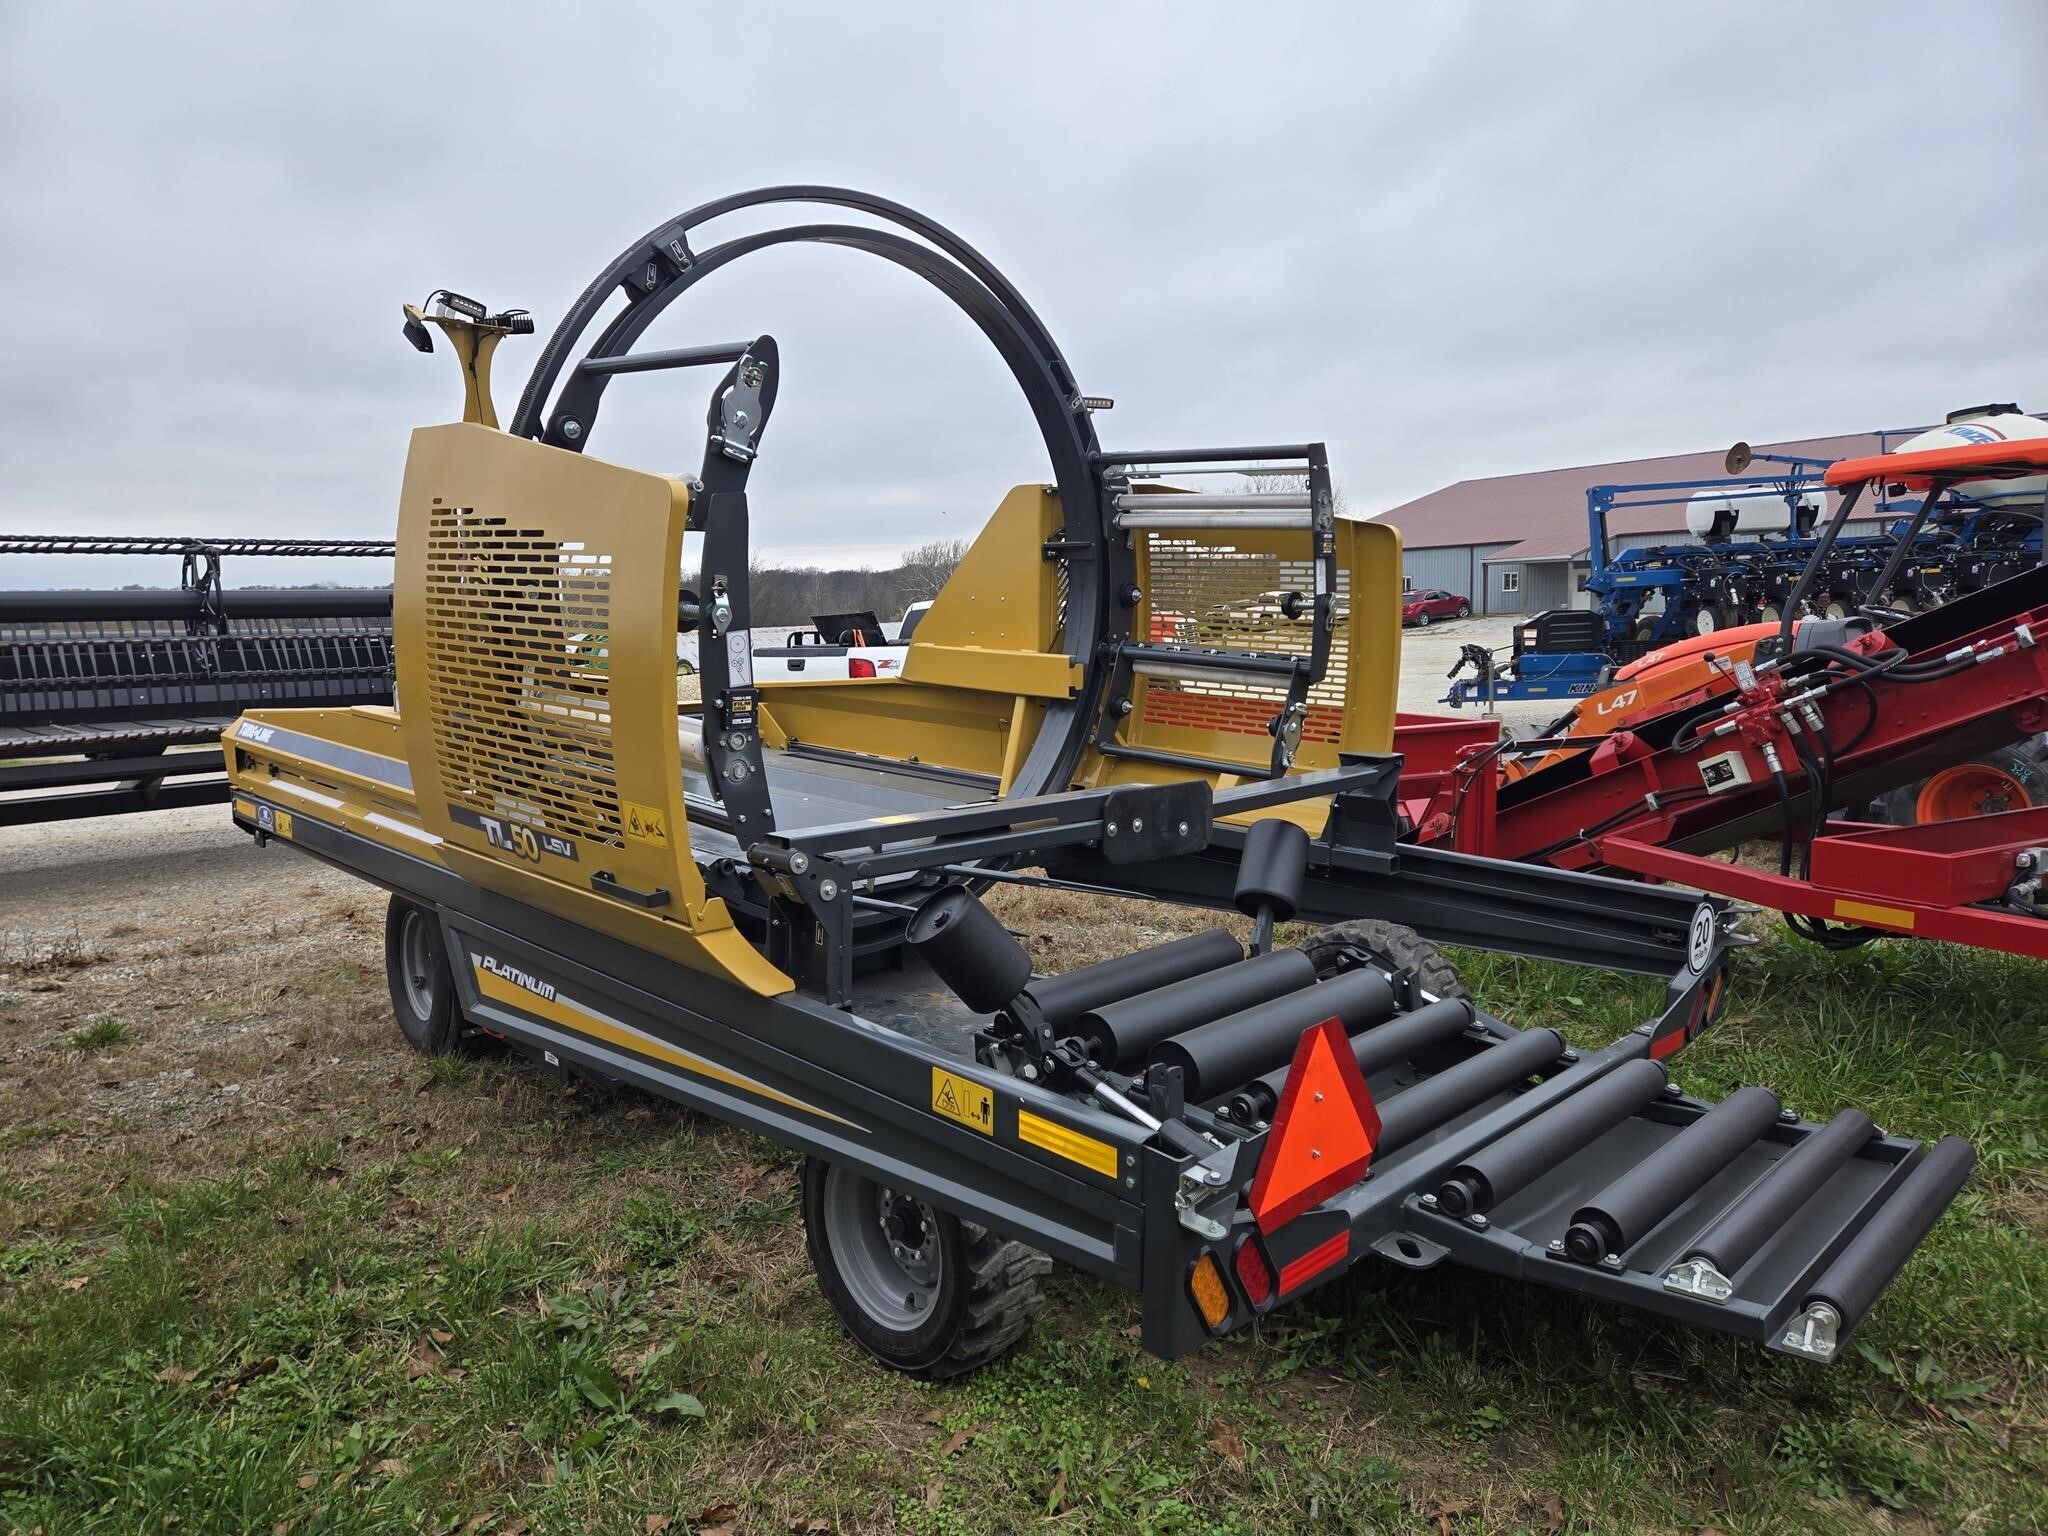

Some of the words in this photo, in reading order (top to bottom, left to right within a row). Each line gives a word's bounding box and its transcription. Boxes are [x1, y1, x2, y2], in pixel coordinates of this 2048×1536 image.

[1637, 653, 1665, 668] L47
[1568, 683, 1599, 694] KIN
[1597, 689, 1638, 716] L47
[1695, 916, 1710, 950] 20
[482, 955, 556, 1001] PLATINUM
